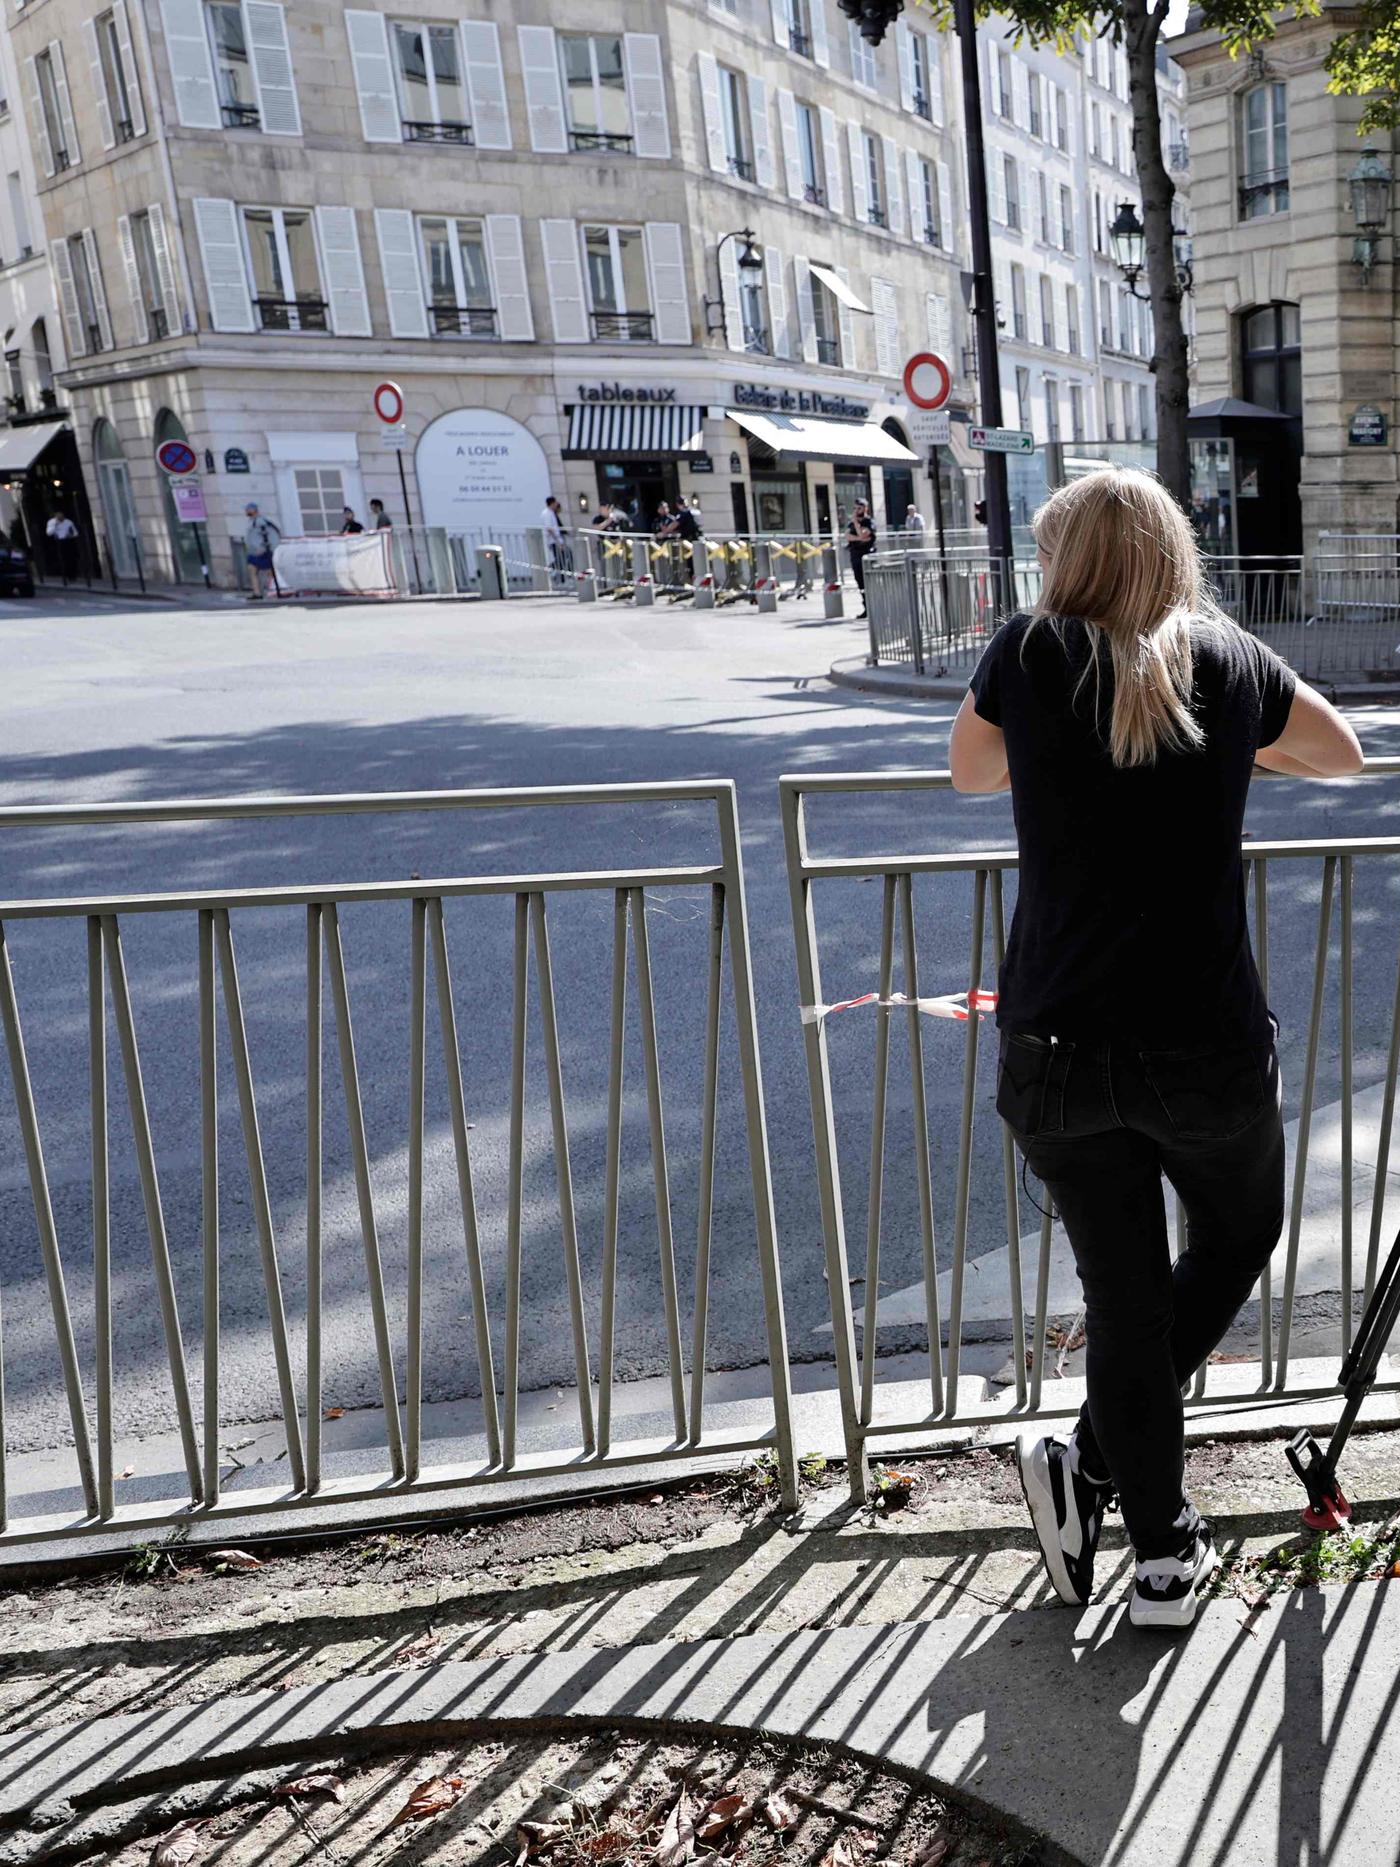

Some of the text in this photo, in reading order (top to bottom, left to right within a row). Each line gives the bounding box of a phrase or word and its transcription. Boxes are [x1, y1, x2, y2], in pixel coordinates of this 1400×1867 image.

[578, 382, 676, 402] tableaux
[780, 389, 796, 410] de
[799, 391, 810, 411] la
[468, 446, 509, 456] LOUER
